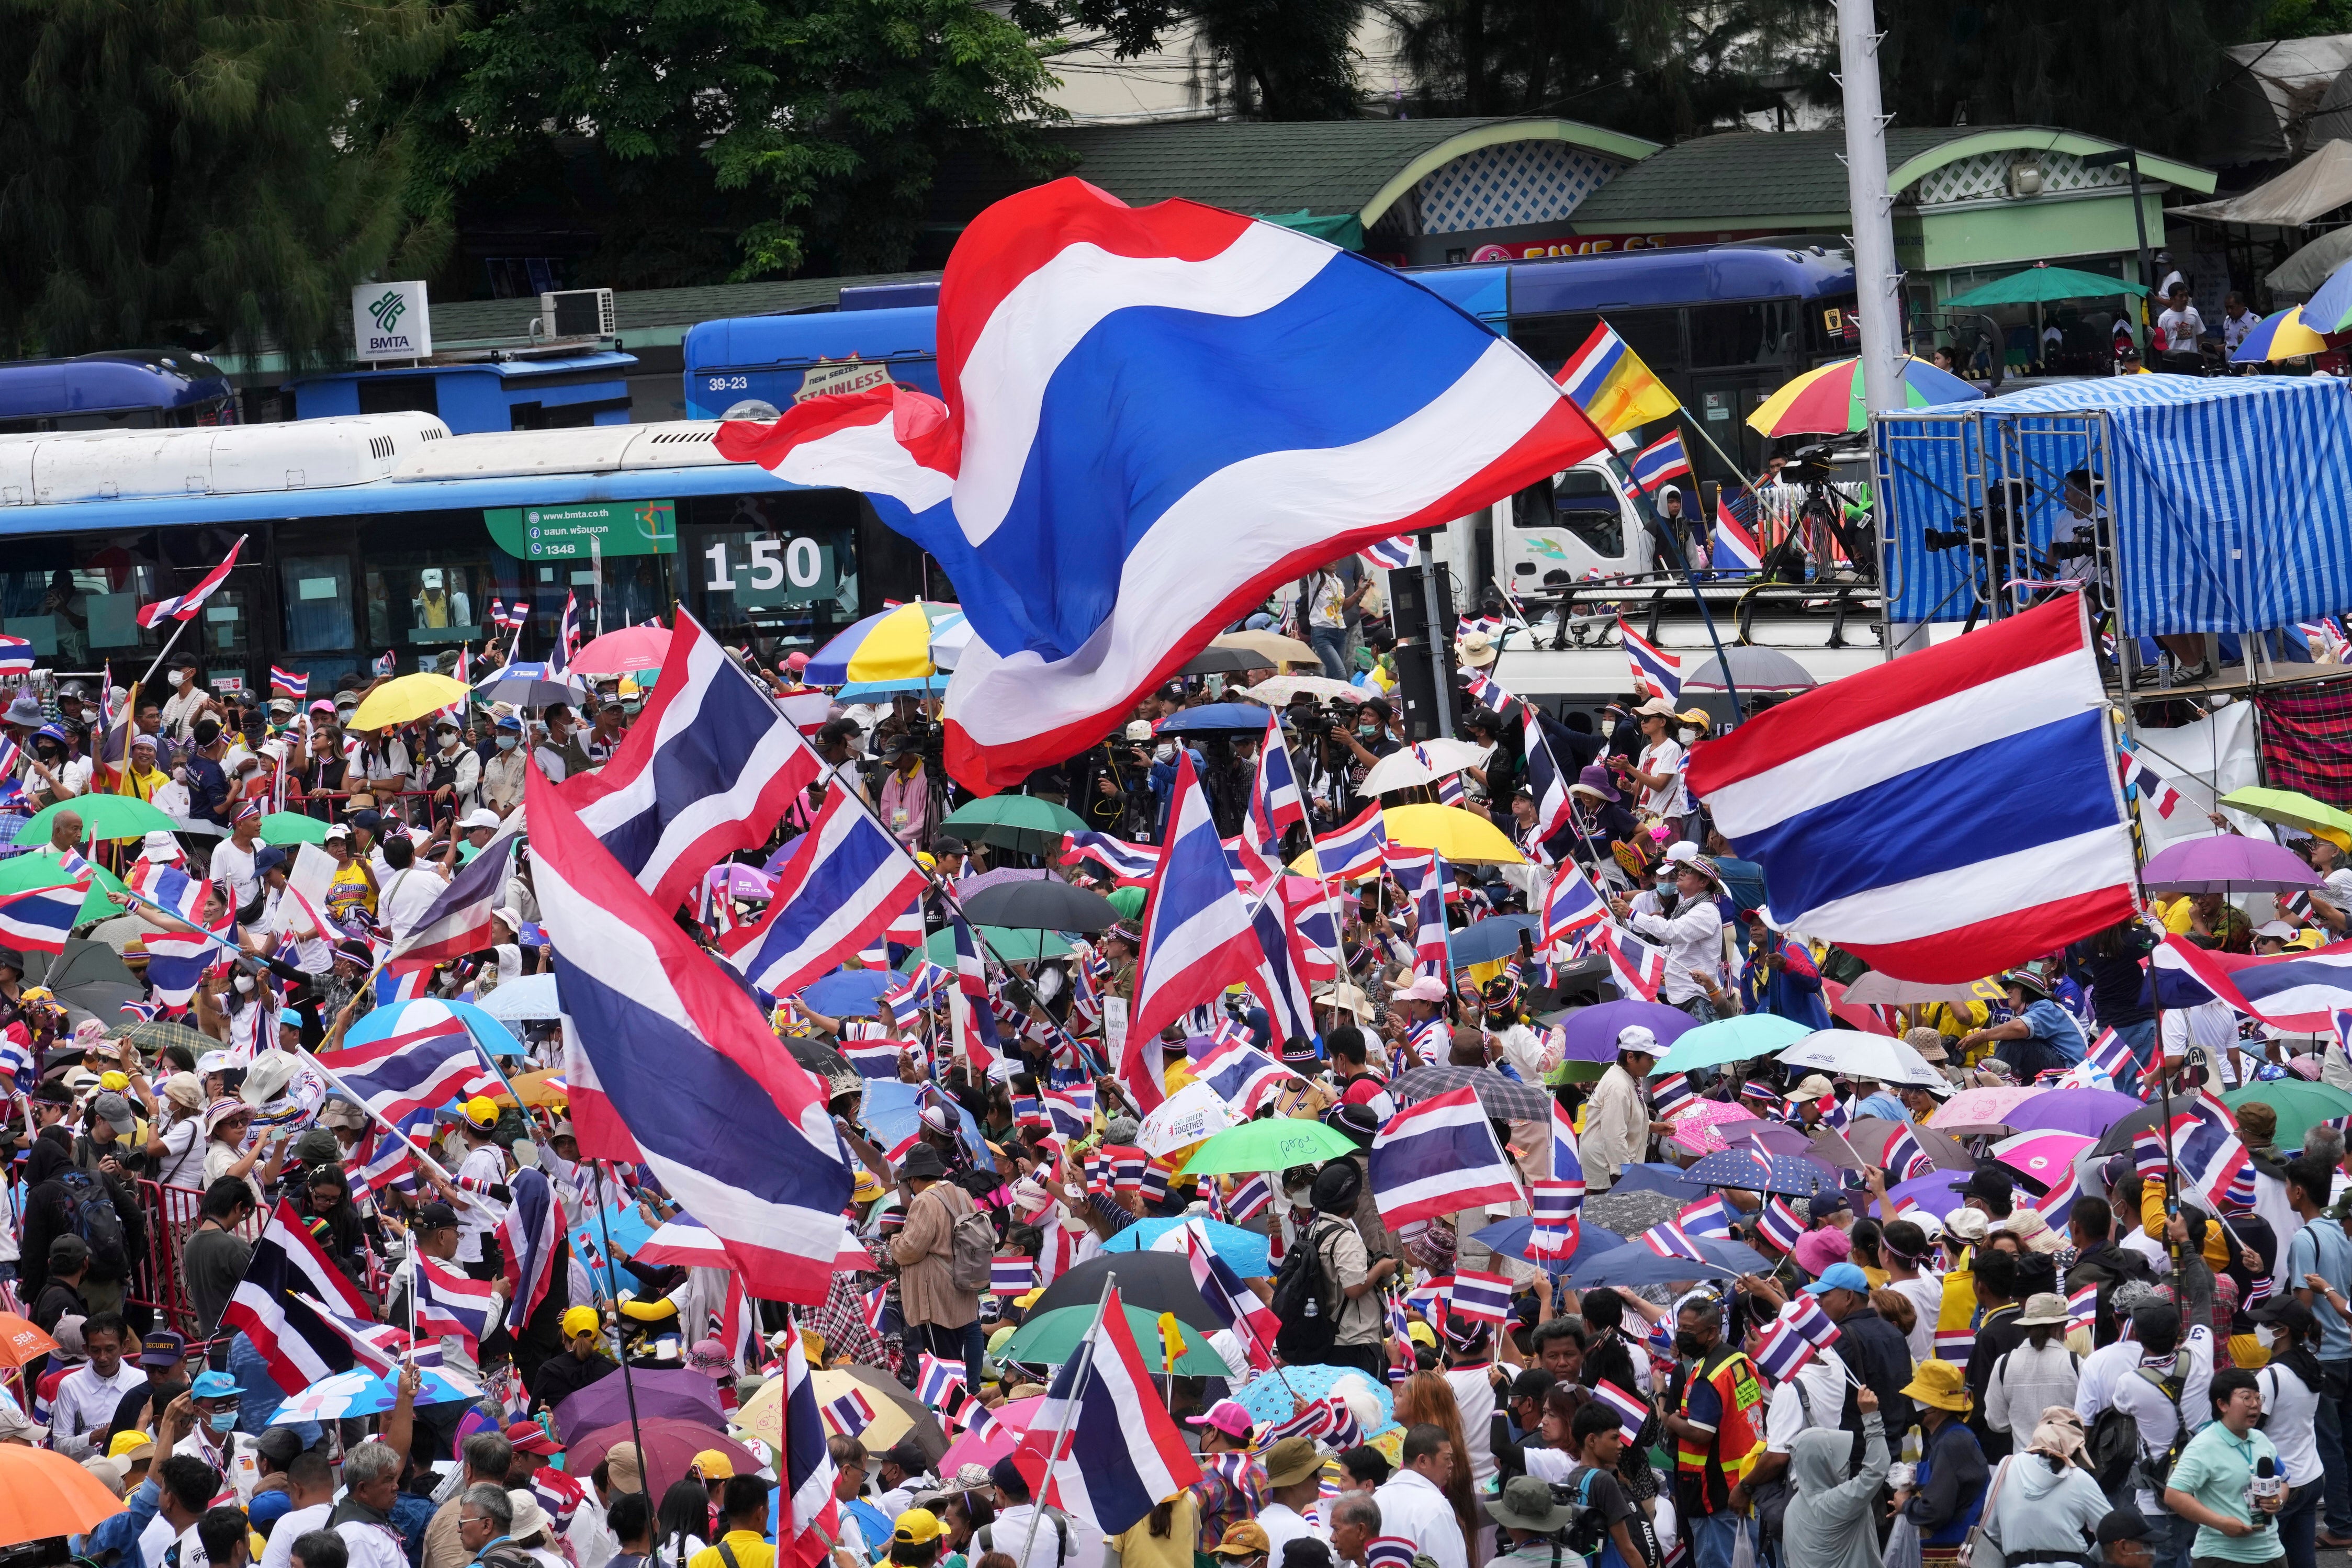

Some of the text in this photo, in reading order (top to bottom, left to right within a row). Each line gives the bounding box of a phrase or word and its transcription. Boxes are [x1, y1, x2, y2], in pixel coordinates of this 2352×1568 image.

[370, 336, 409, 349] BMTA
[828, 365, 858, 379] SERIES
[709, 376, 747, 391] 39-23
[543, 509, 609, 520] www.bmta.co.th
[571, 525, 609, 535] พร้อมบวก
[546, 545, 576, 555] 1348
[706, 537, 821, 592] 1-50
[1185, 1112, 1203, 1123] GREEN
[1175, 1119, 1203, 1134] TOGETHER
[13, 1330, 36, 1345] SBA
[1641, 1520, 1655, 1567] VICTORY
